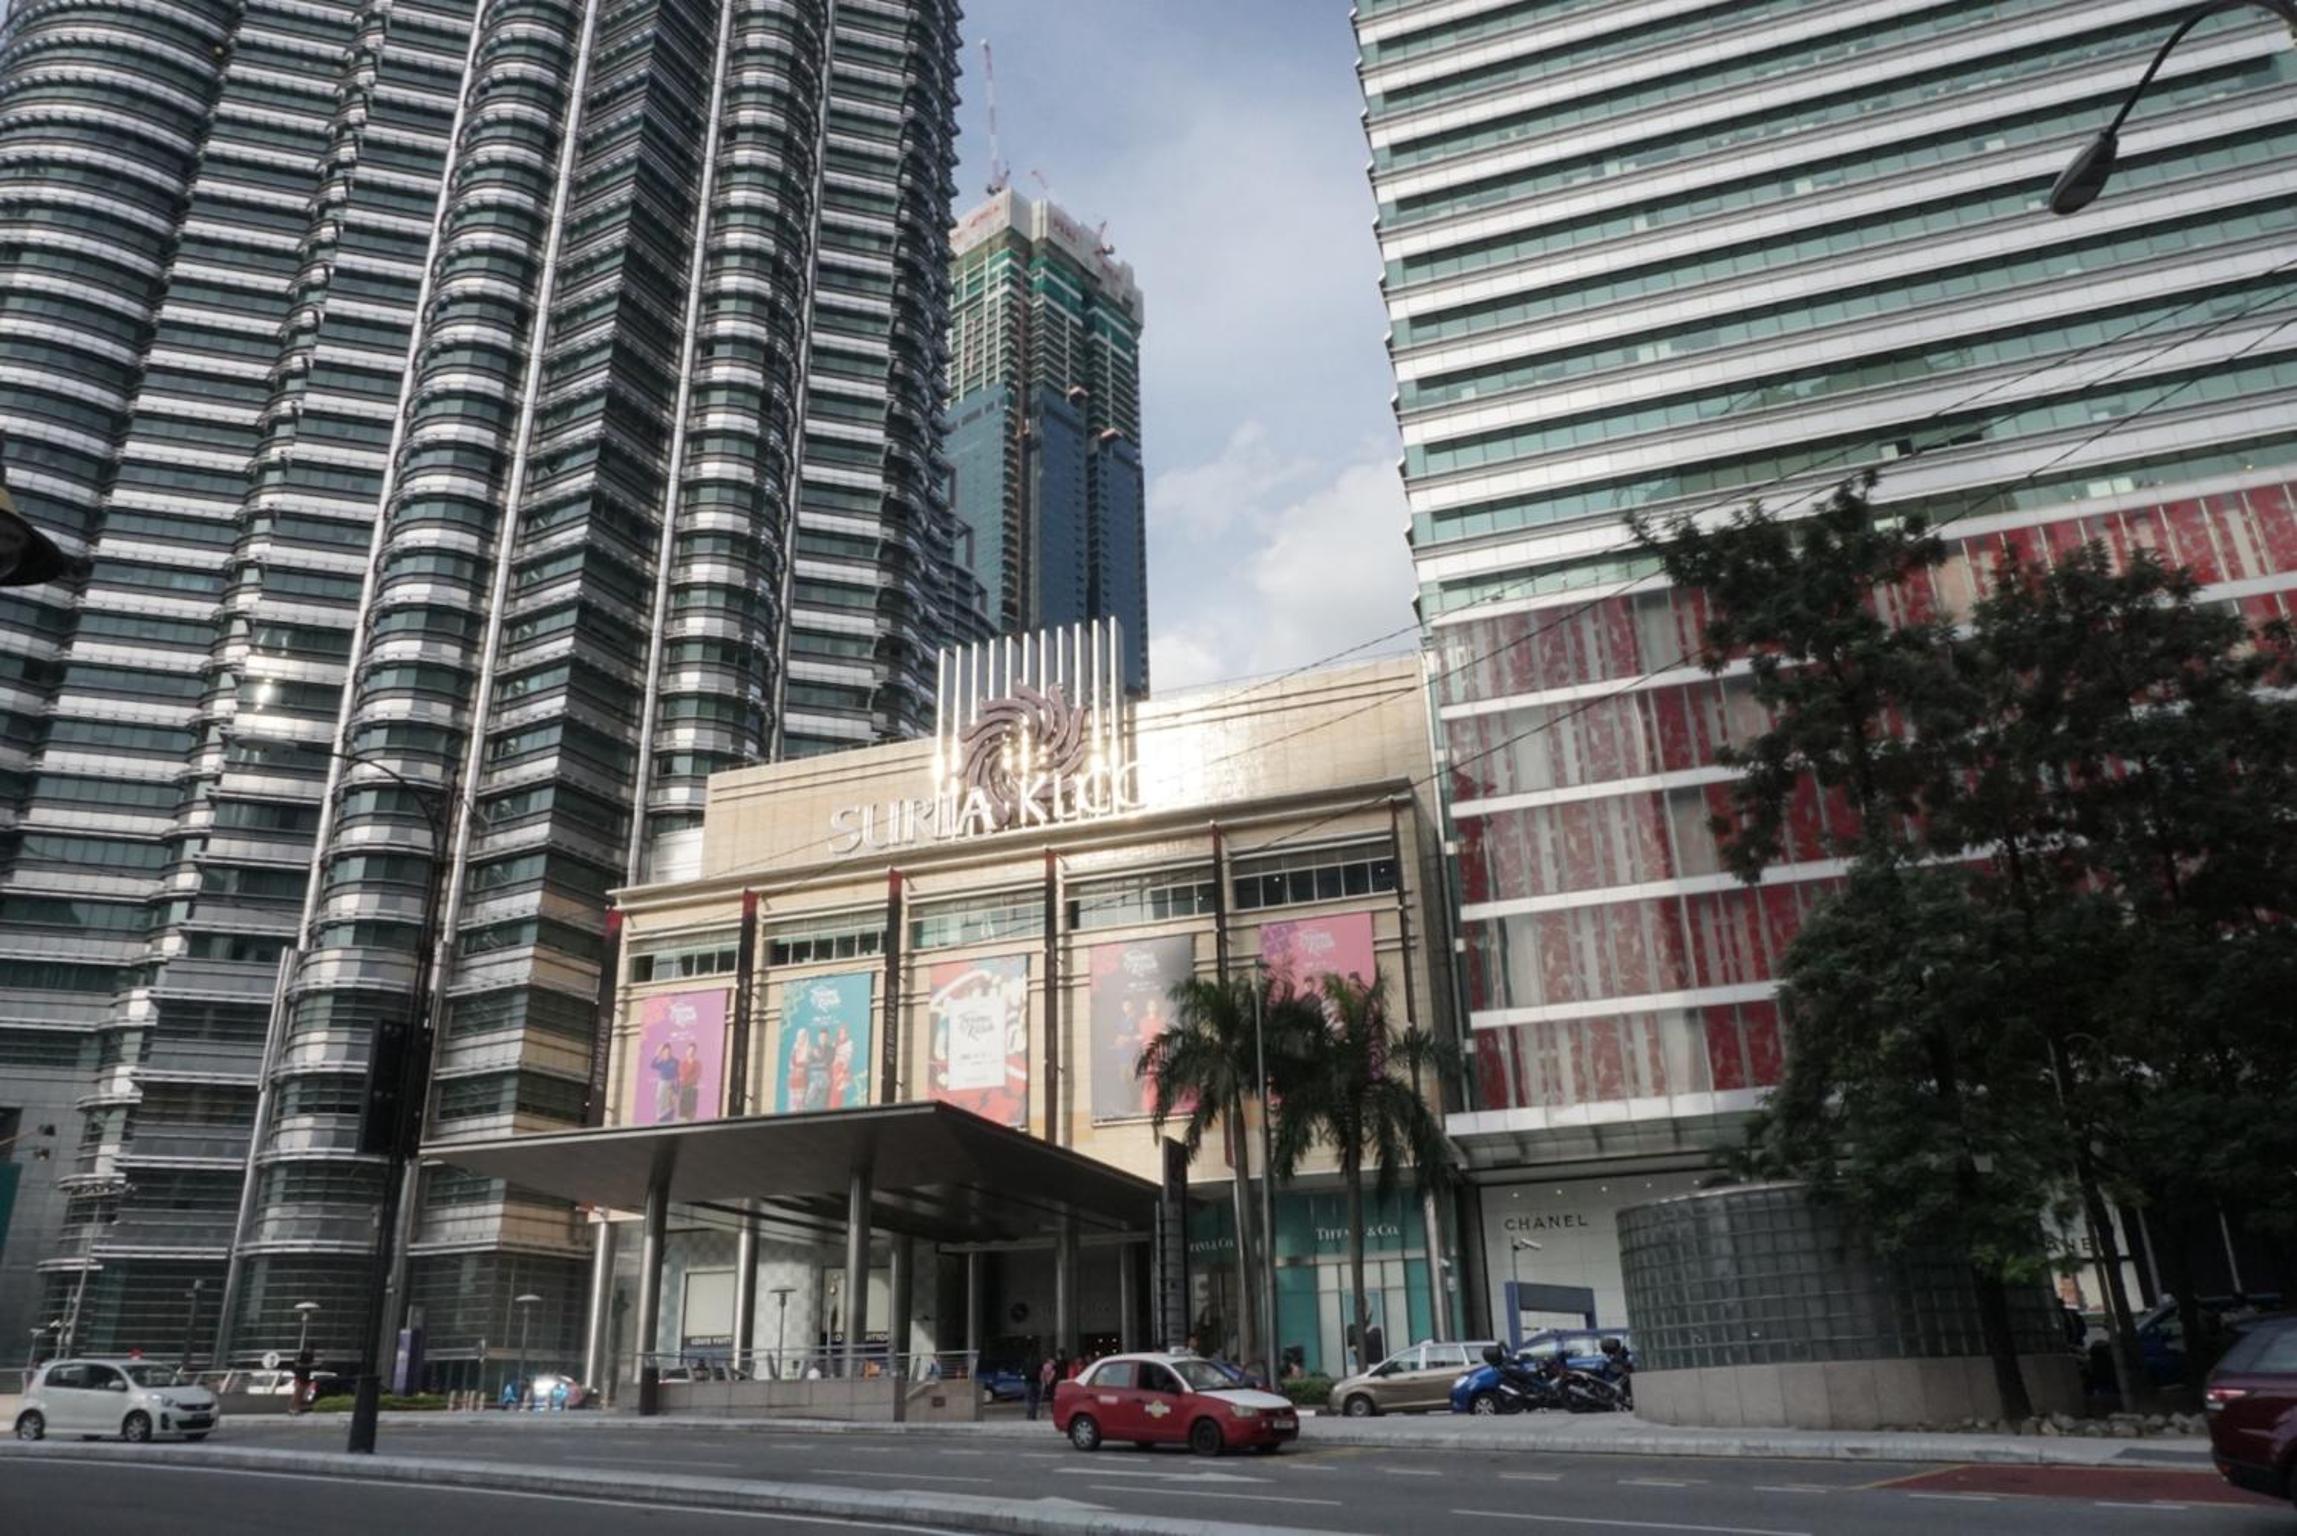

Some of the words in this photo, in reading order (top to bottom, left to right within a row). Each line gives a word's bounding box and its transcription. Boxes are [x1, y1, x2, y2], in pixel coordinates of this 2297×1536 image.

[829, 785, 998, 855] SURIA
[1018, 760, 1150, 827] KLCC
[1504, 1214, 1588, 1232] CHANEL
